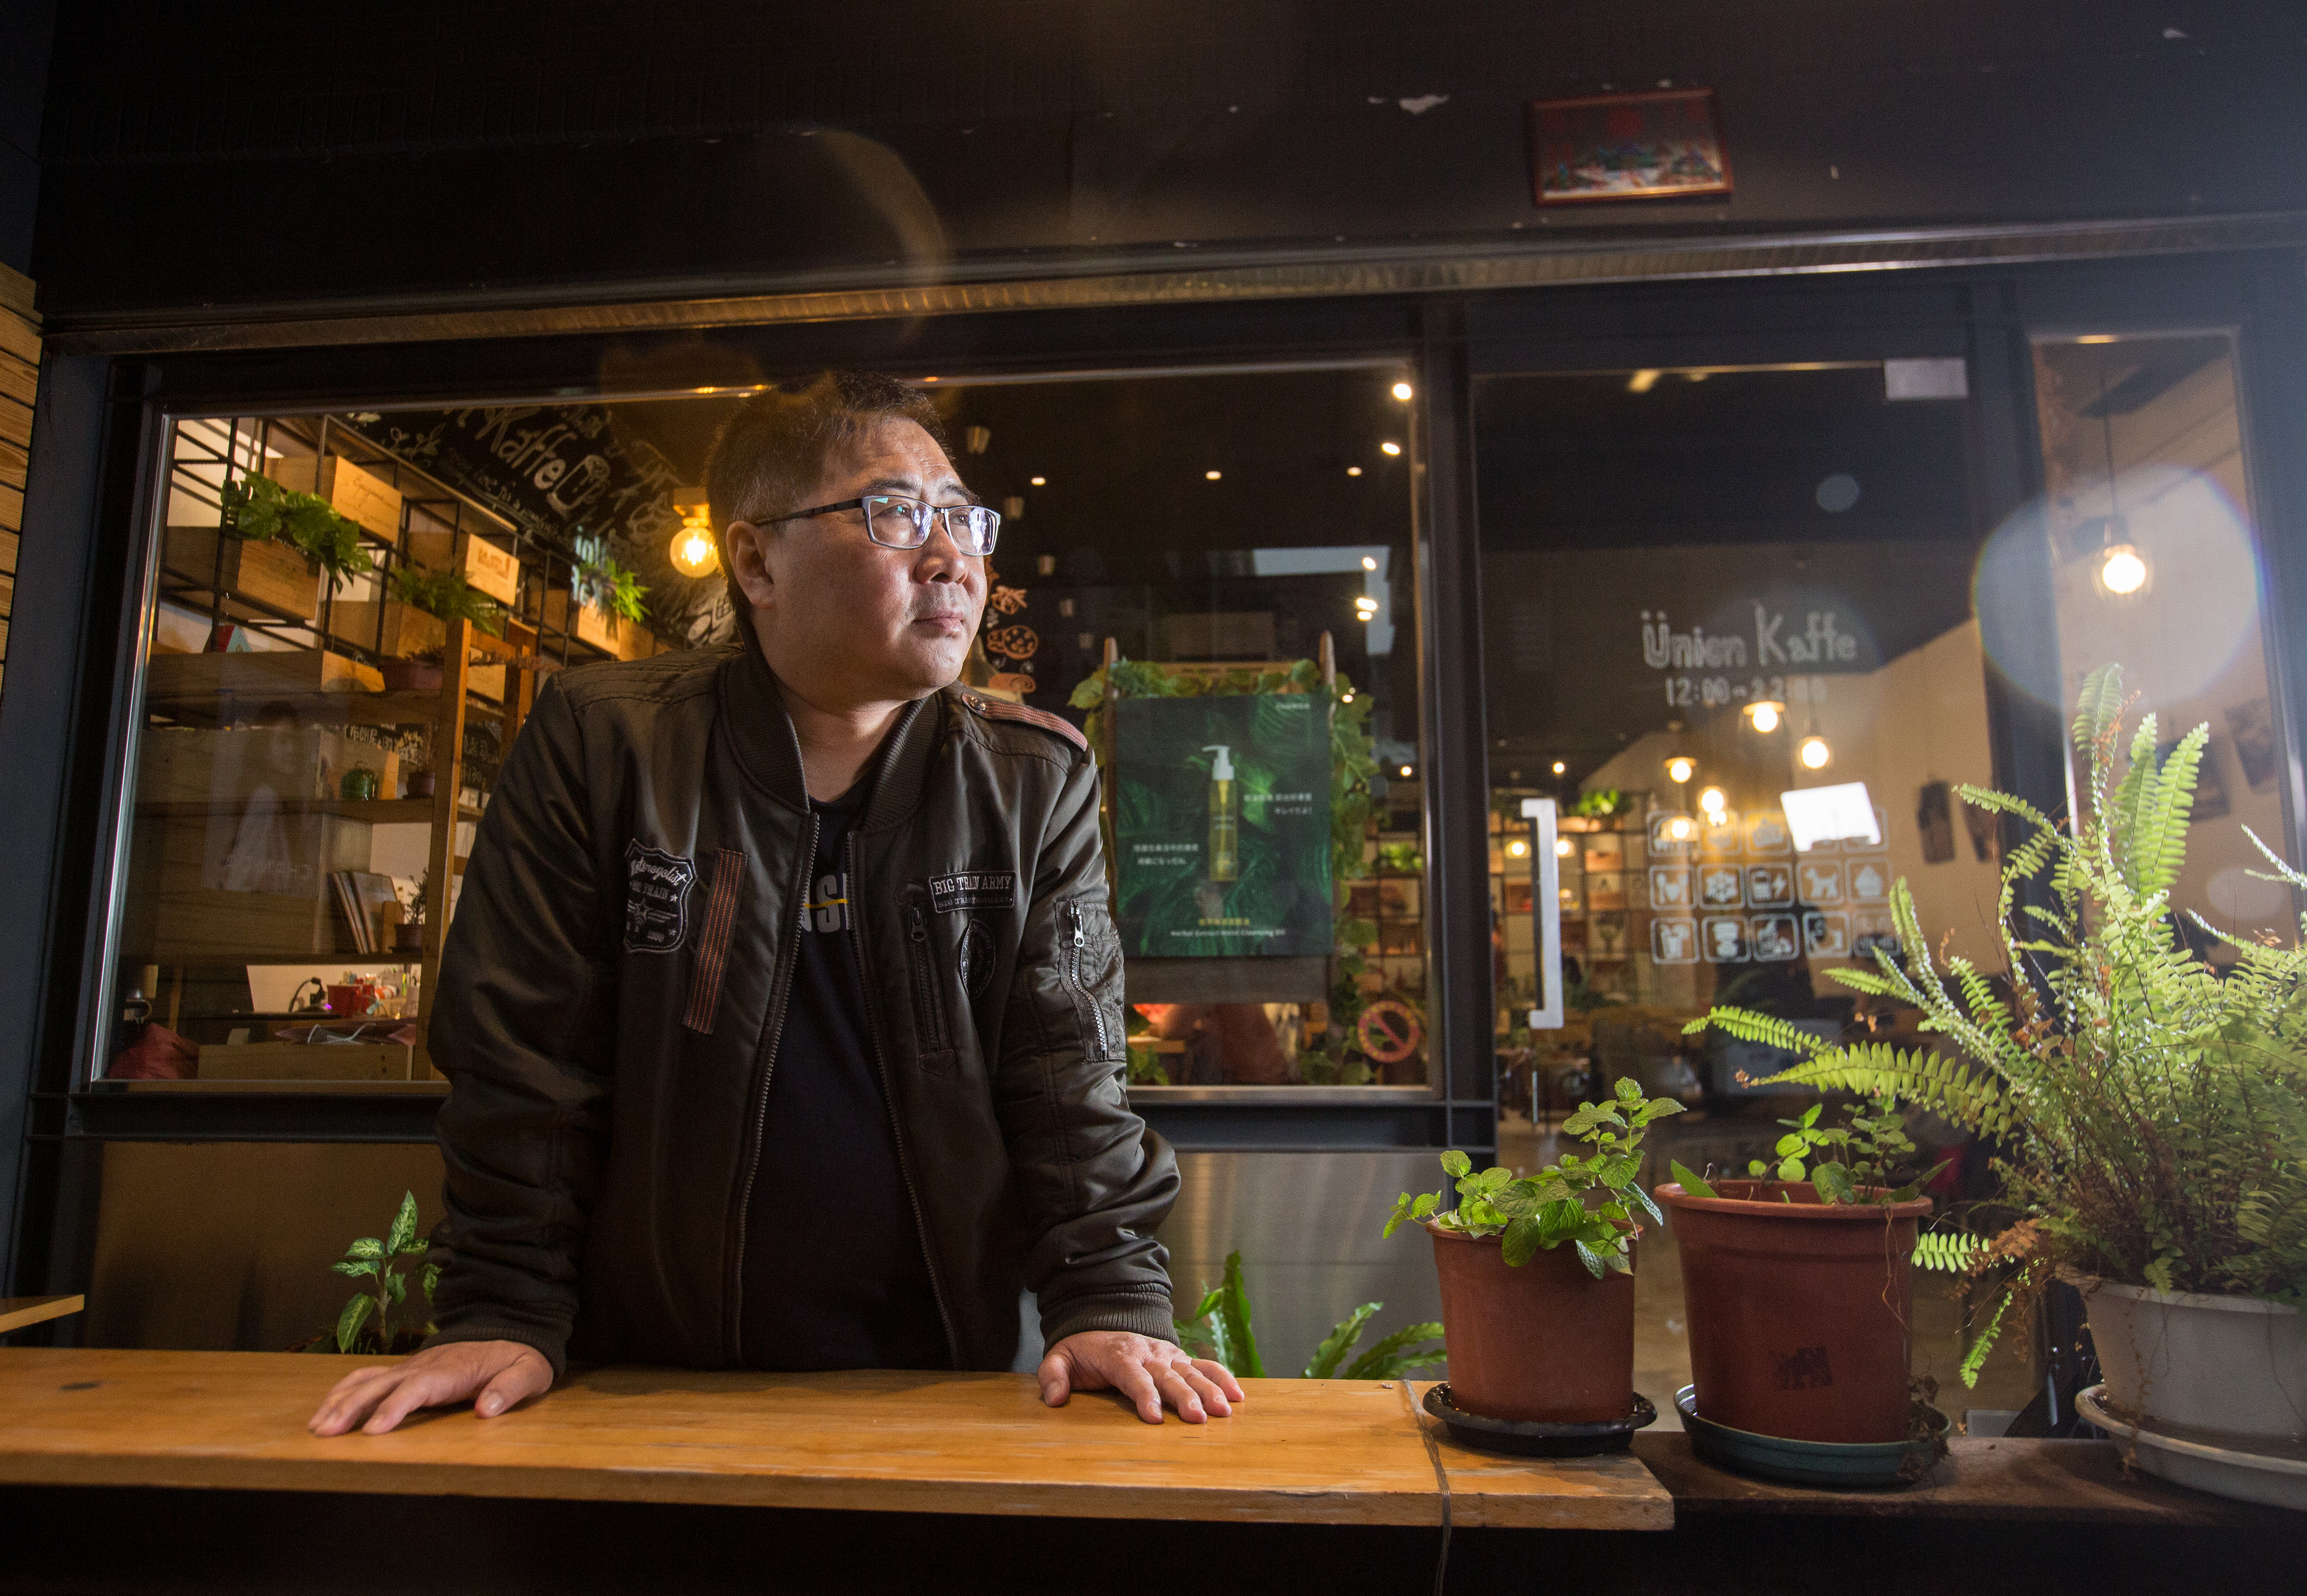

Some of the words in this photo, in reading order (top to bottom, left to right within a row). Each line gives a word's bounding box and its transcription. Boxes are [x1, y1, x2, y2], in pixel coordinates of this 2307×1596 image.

[1754, 604, 1857, 667] Kaffe
[933, 878, 955, 895] BIG
[956, 876, 980, 891] TRAIN
[981, 875, 1012, 890] ARMY
